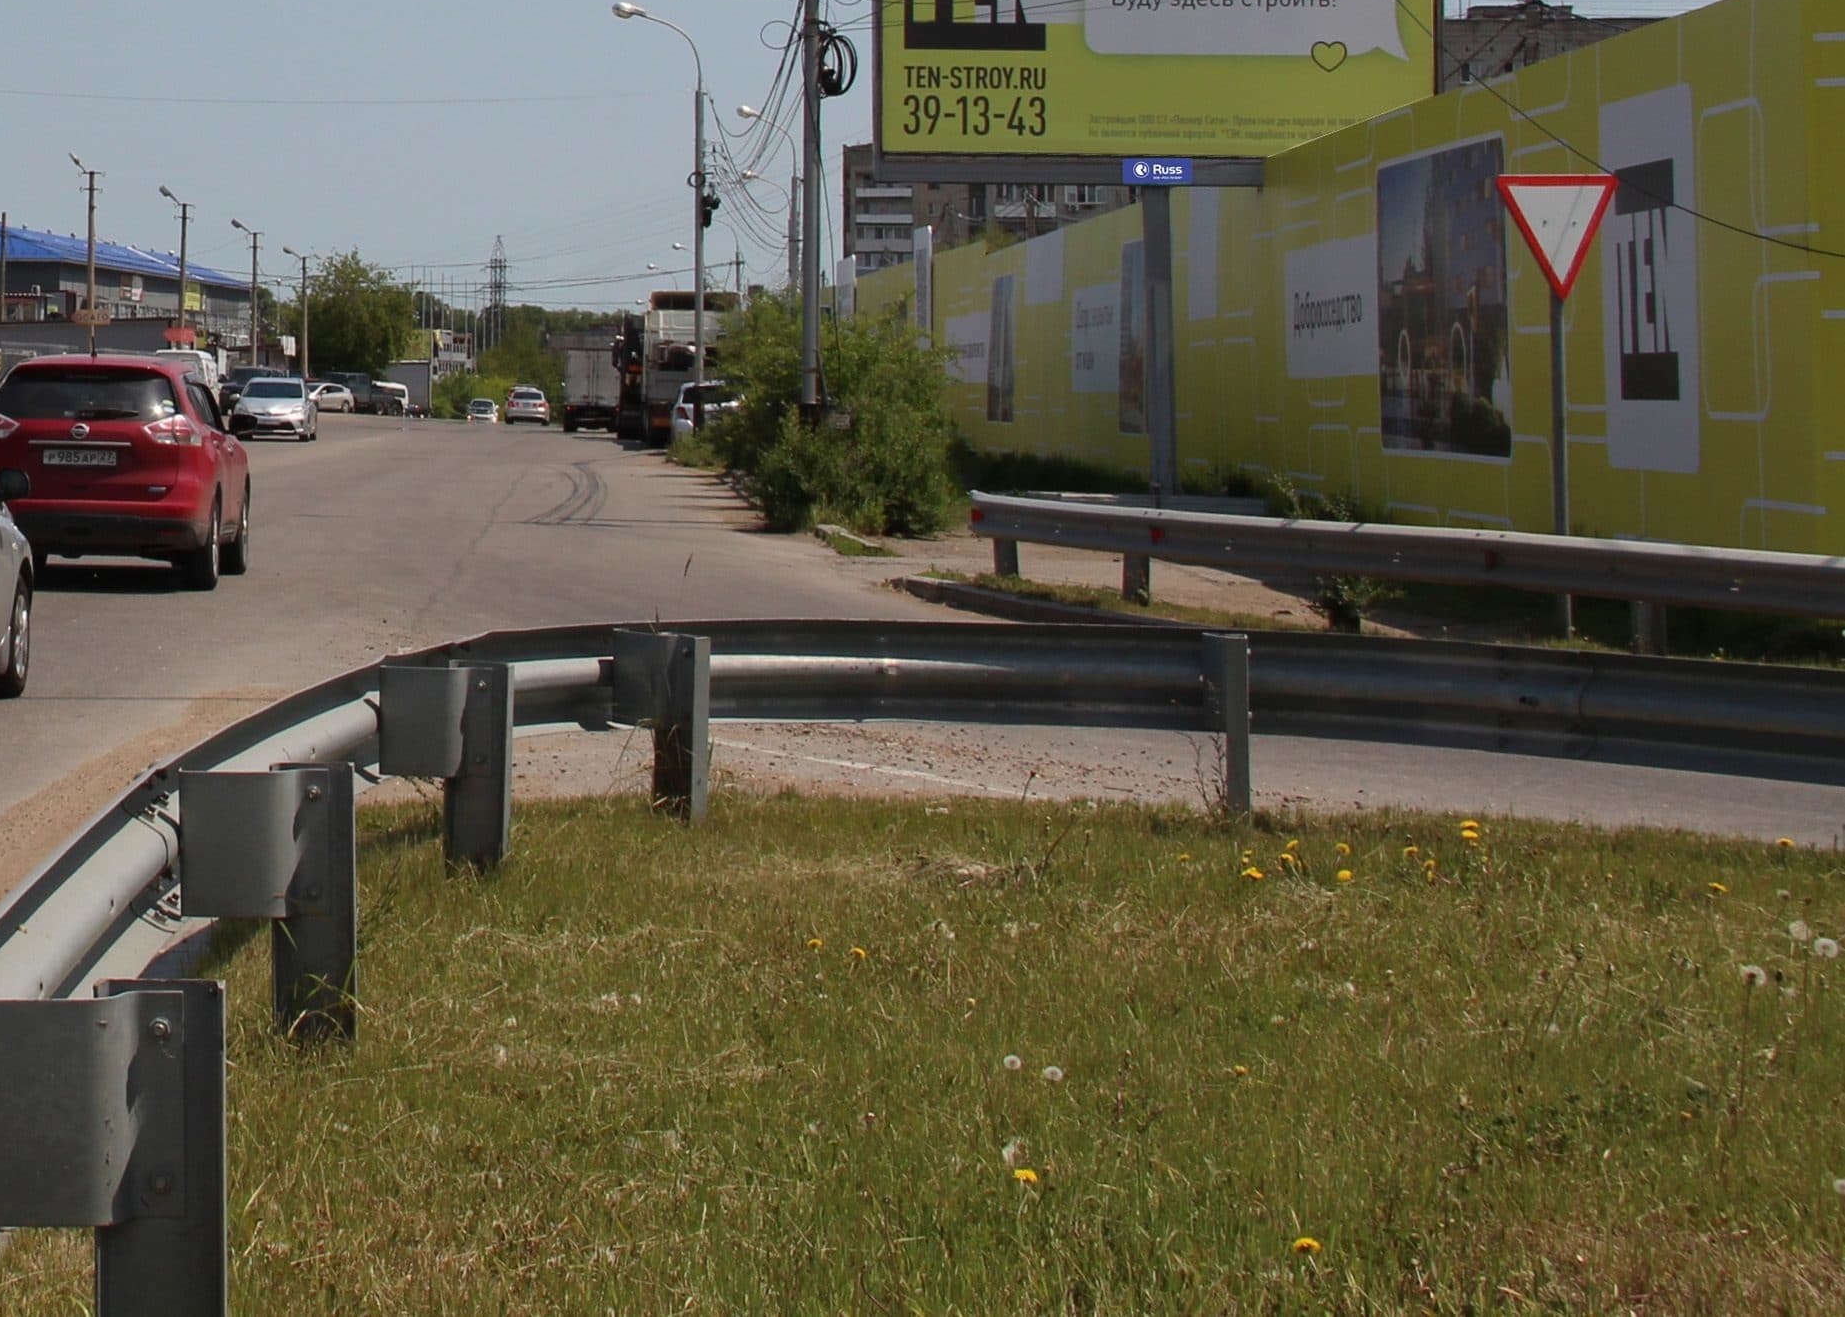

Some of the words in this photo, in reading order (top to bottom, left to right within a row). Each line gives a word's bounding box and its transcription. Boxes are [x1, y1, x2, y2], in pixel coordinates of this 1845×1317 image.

[904, 66, 1047, 90] TEN-STROY.RU
[903, 94, 1047, 136] 39-13-43
[1152, 163, 1184, 175] Russ
